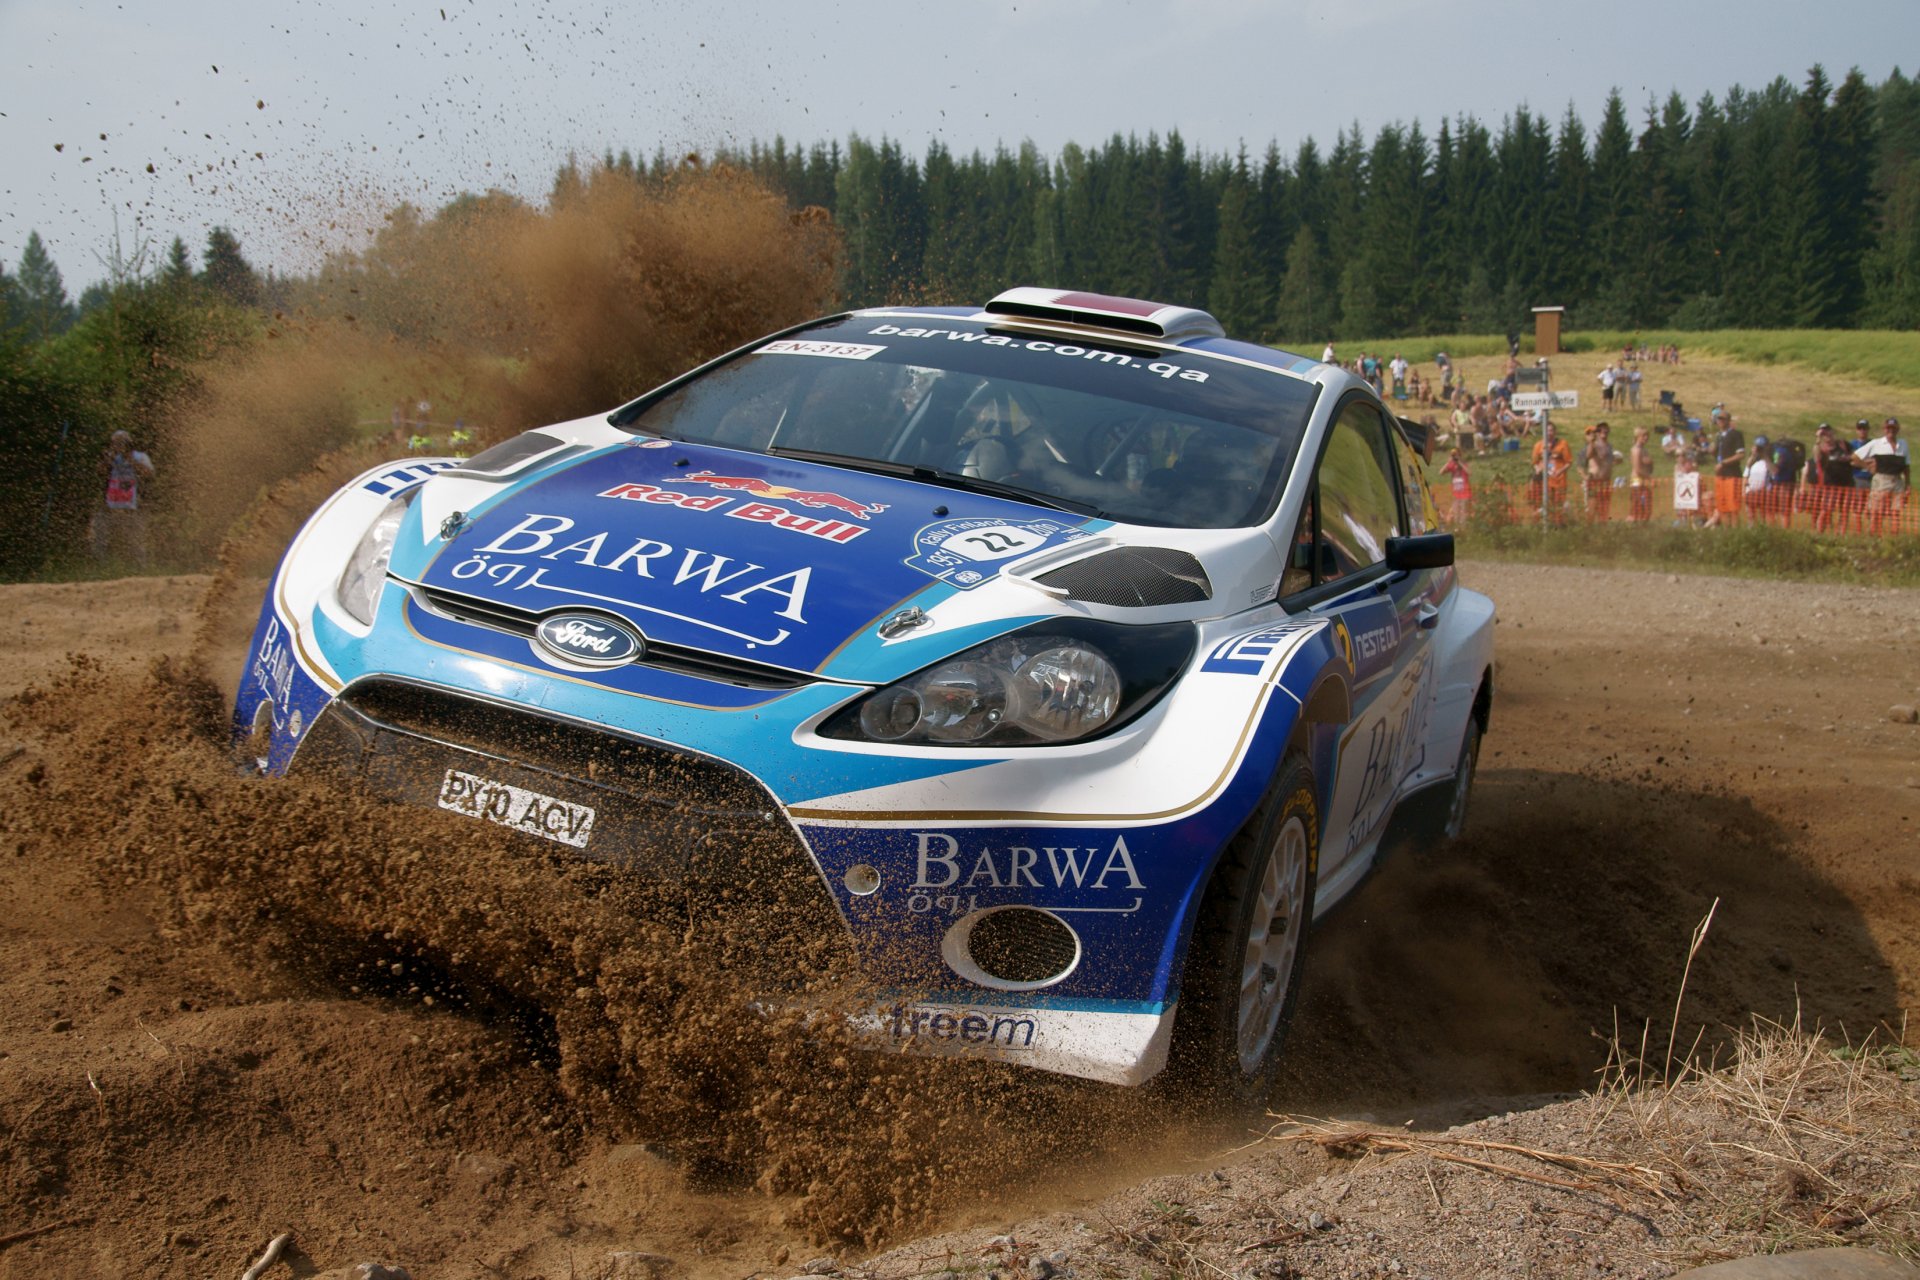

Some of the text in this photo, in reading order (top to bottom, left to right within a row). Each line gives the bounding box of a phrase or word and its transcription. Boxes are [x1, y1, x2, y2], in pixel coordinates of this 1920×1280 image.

[767, 342, 874, 356] EN-3137
[867, 324, 1210, 384] barwa.com.qa
[599, 482, 869, 543] Red Bull
[920, 519, 1007, 546] Rally Finland
[965, 532, 1025, 553] 22
[926, 549, 971, 567] 1951
[555, 620, 612, 653] Ford
